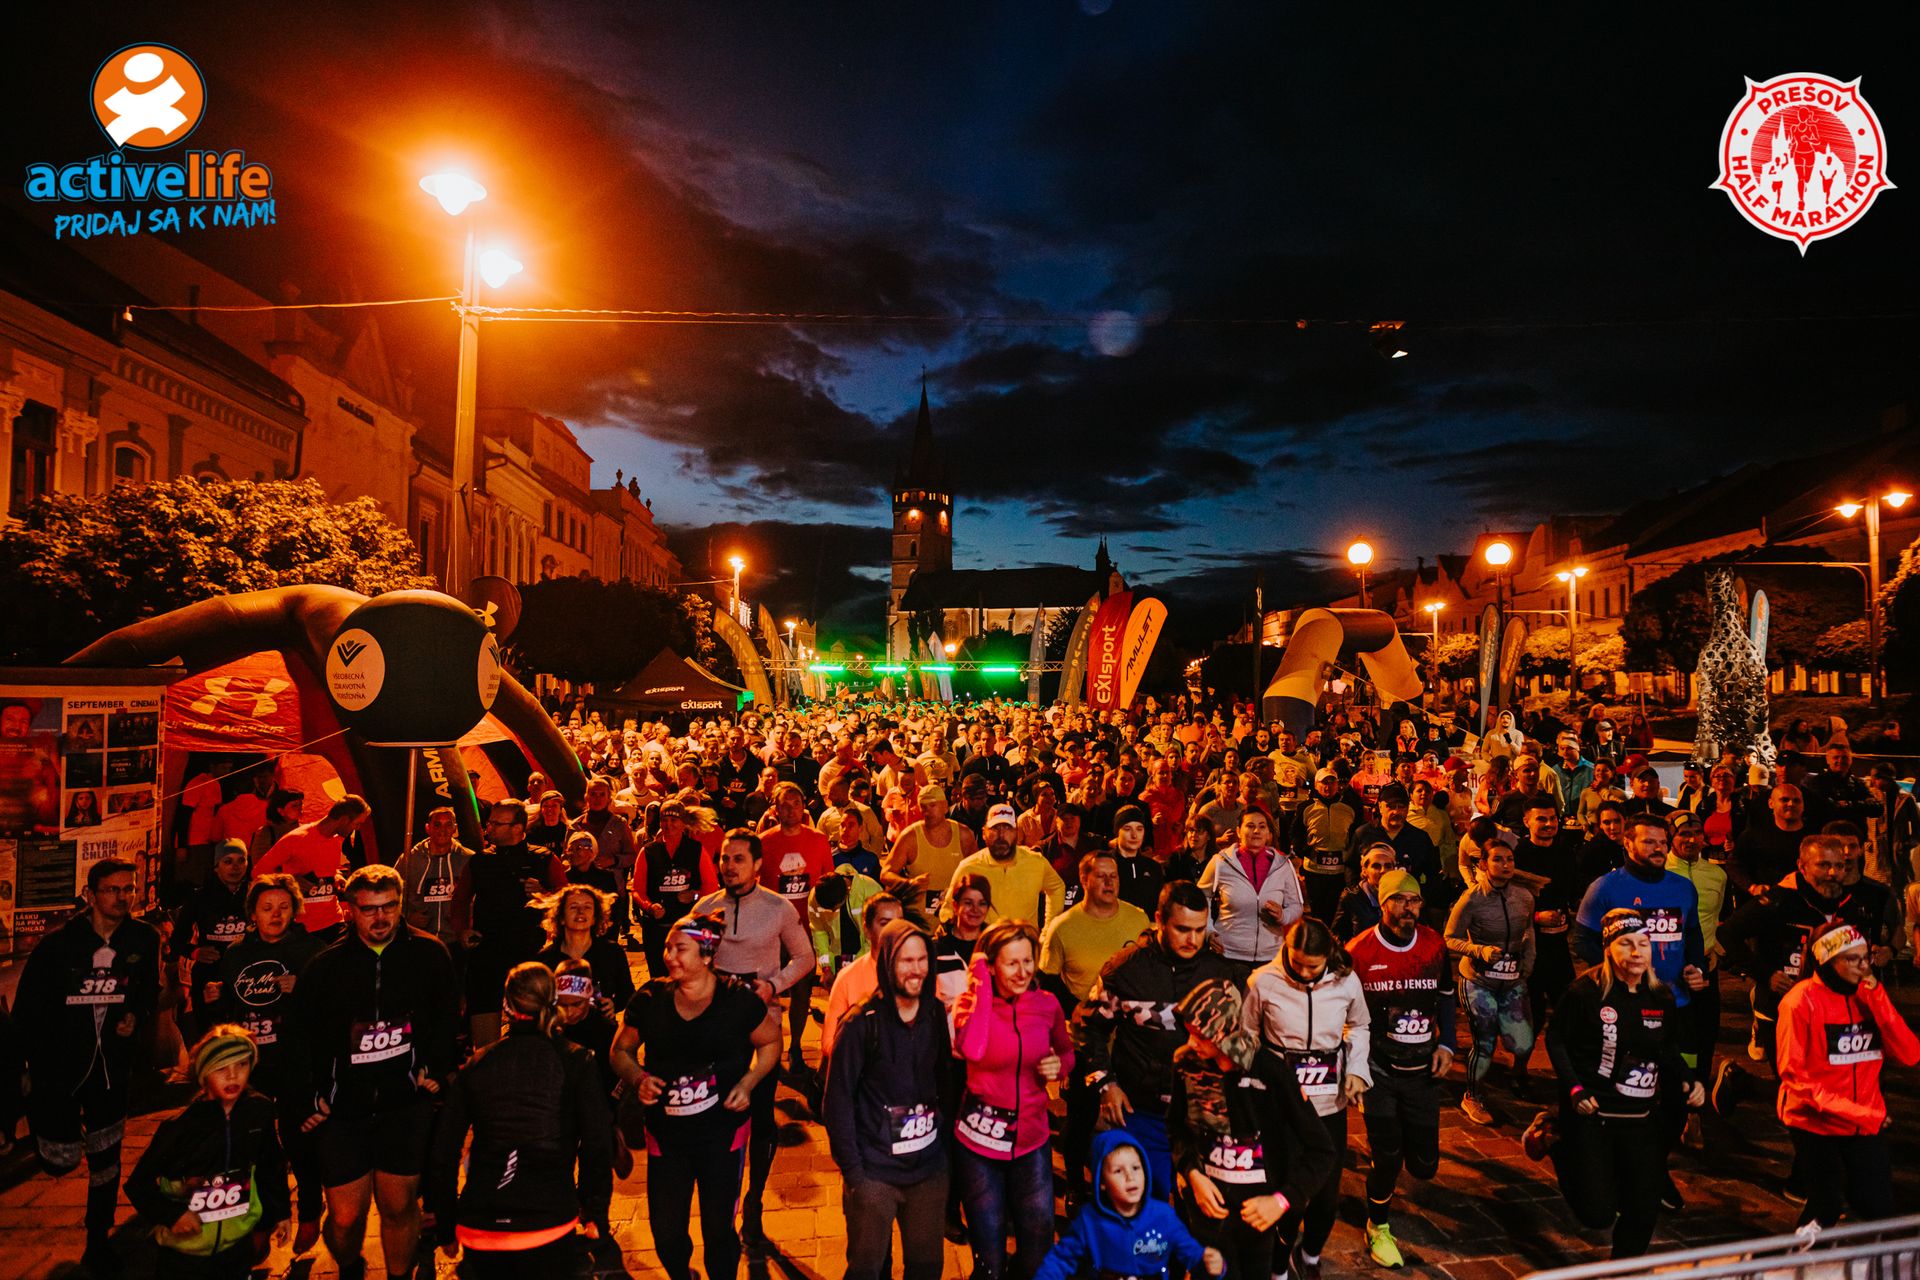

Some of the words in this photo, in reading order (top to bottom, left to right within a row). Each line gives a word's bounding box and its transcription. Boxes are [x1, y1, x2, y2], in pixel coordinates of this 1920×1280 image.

[67, 701, 124, 709] SEPTEMBER
[422, 748, 453, 799] ARM
[1321, 856, 1339, 866] 130
[663, 875, 686, 886] 258
[786, 882, 806, 893] 197
[309, 884, 333, 896] 649
[429, 884, 454, 896] 530
[214, 922, 246, 934] 398
[1493, 960, 1517, 972] 415
[79, 979, 118, 994] 318
[1363, 980, 1394, 992] GLUNZ
[1395, 980, 1402, 990] &
[1404, 978, 1438, 990] JENSEN
[1394, 1018, 1429, 1034] 303
[359, 1028, 403, 1051] 505
[1837, 1033, 1874, 1053] 607
[1598, 1024, 1617, 1078] SPARTAN
[1295, 1066, 1328, 1085] 177
[667, 1081, 709, 1106] 294
[900, 1112, 936, 1139] 485
[966, 1112, 1008, 1139] 455
[1209, 1146, 1254, 1170] 454
[188, 1185, 242, 1212] 506
